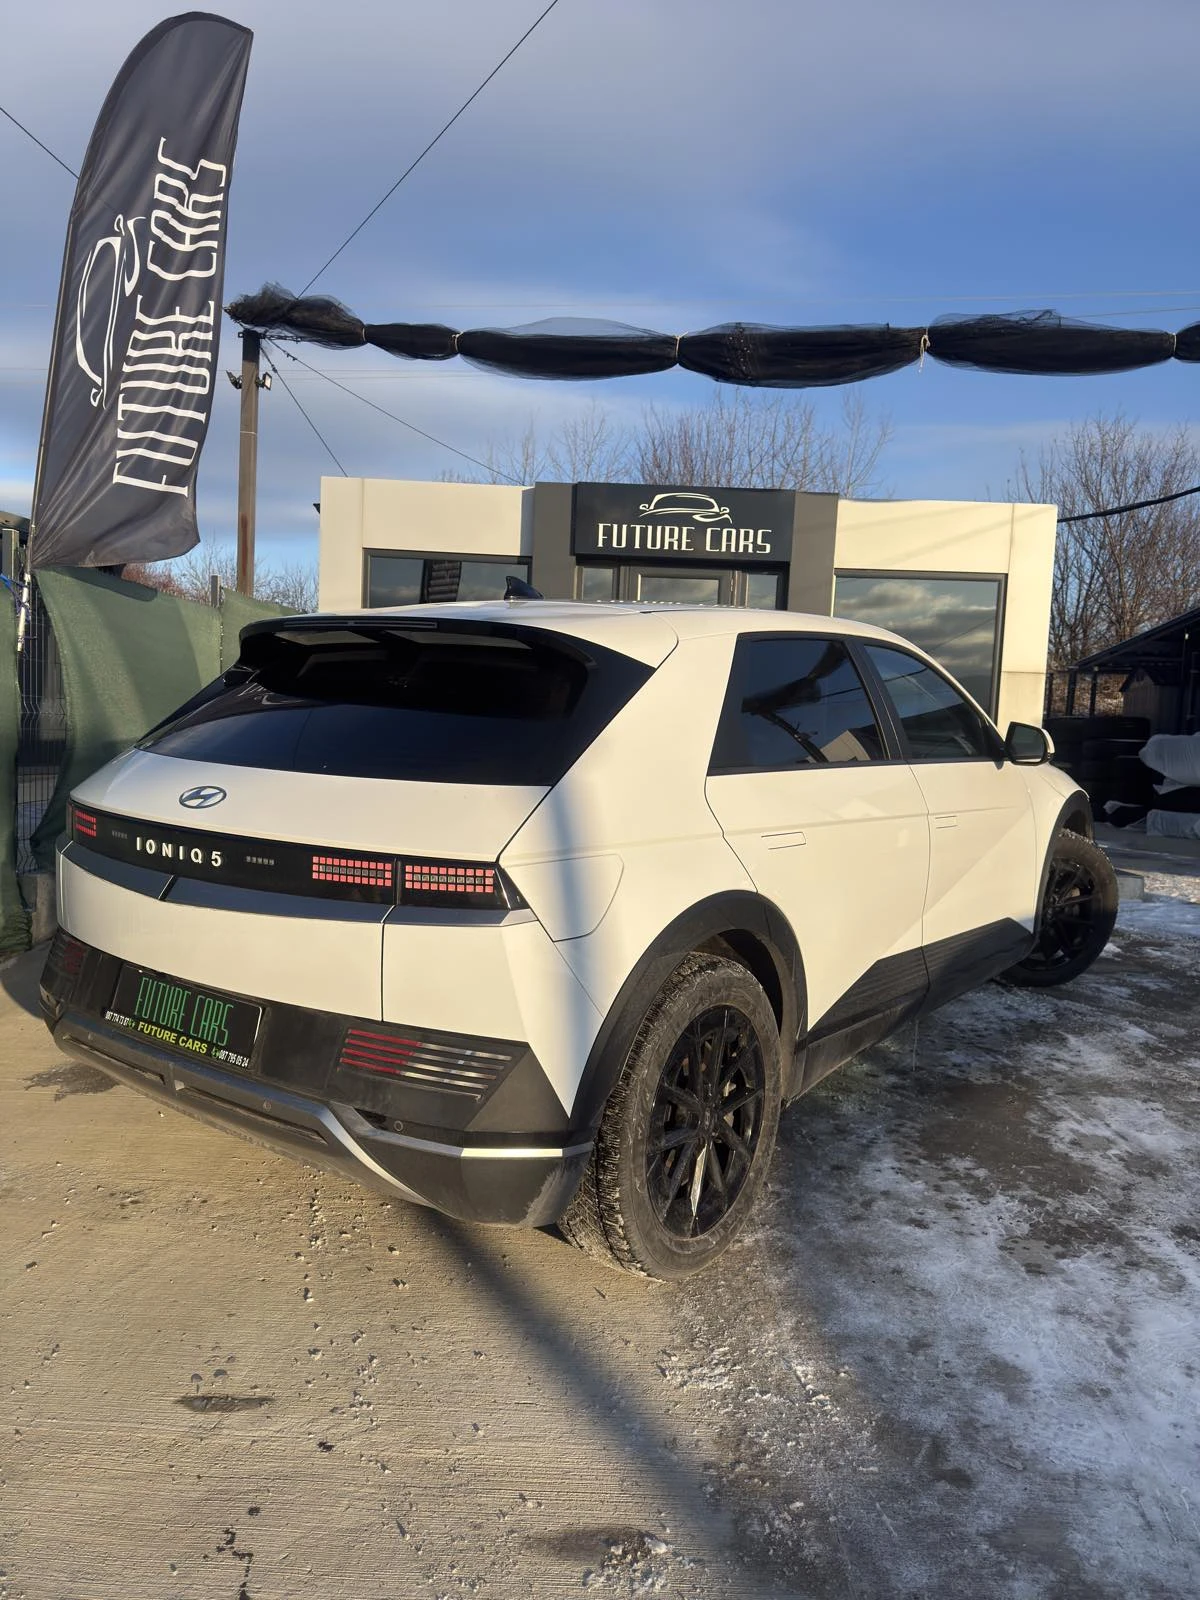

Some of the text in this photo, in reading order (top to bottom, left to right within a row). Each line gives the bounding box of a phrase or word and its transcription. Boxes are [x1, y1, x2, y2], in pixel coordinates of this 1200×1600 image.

[112, 136, 227, 497] FUTURE CARS
[597, 522, 773, 554] FUTURE CARS
[136, 836, 222, 867] IONIQ 5
[134, 977, 234, 1047] FUTURE CARS
[137, 1021, 208, 1054] FUTURE CARS
